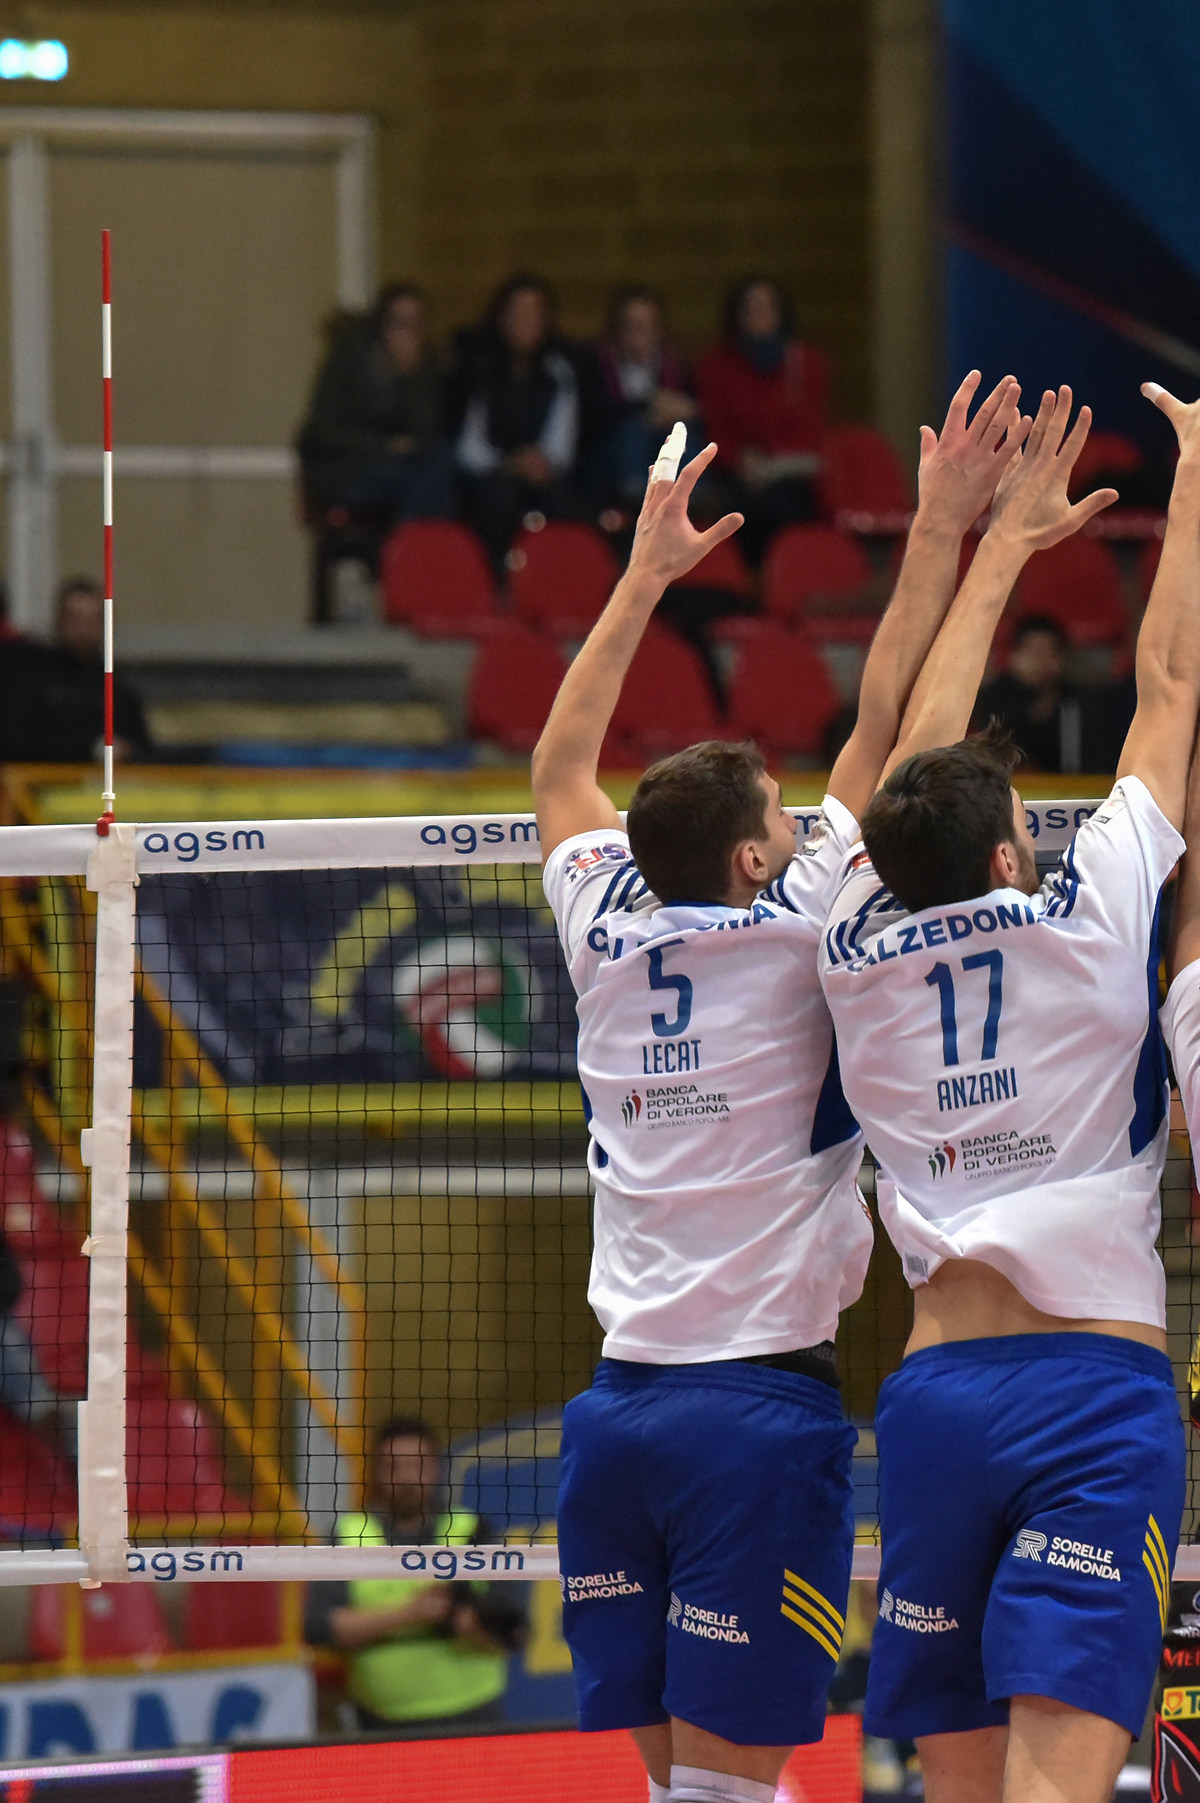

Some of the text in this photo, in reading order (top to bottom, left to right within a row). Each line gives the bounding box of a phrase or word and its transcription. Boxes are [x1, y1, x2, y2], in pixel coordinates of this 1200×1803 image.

[143, 829, 265, 862] agsm
[420, 821, 541, 854] agsm
[645, 938, 693, 1037] 5
[924, 949, 1003, 1066] 17
[643, 1040, 701, 1075] LECAT
[646, 1085, 698, 1098] BANCA
[647, 1093, 727, 1109] POPOLARE
[937, 1067, 1018, 1112] ANZANI
[647, 1104, 730, 1120] DI VERONA
[961, 1130, 1019, 1148] BANCA
[962, 1134, 1052, 1159] POPOLARE
[964, 1145, 1057, 1171] DI VERONA
[1051, 1537, 1114, 1564] SORELLE
[127, 1550, 243, 1580] agsm
[401, 1549, 525, 1580] agsm
[1047, 1552, 1121, 1582] RAMONDA
[567, 1571, 627, 1589] SORELLE
[569, 1582, 644, 1602] RAMONDA
[684, 1604, 738, 1628] SORELLE
[896, 1599, 945, 1619] SORELLE
[681, 1618, 750, 1644] RAMONDA
[895, 1614, 959, 1633] RAMONDA
